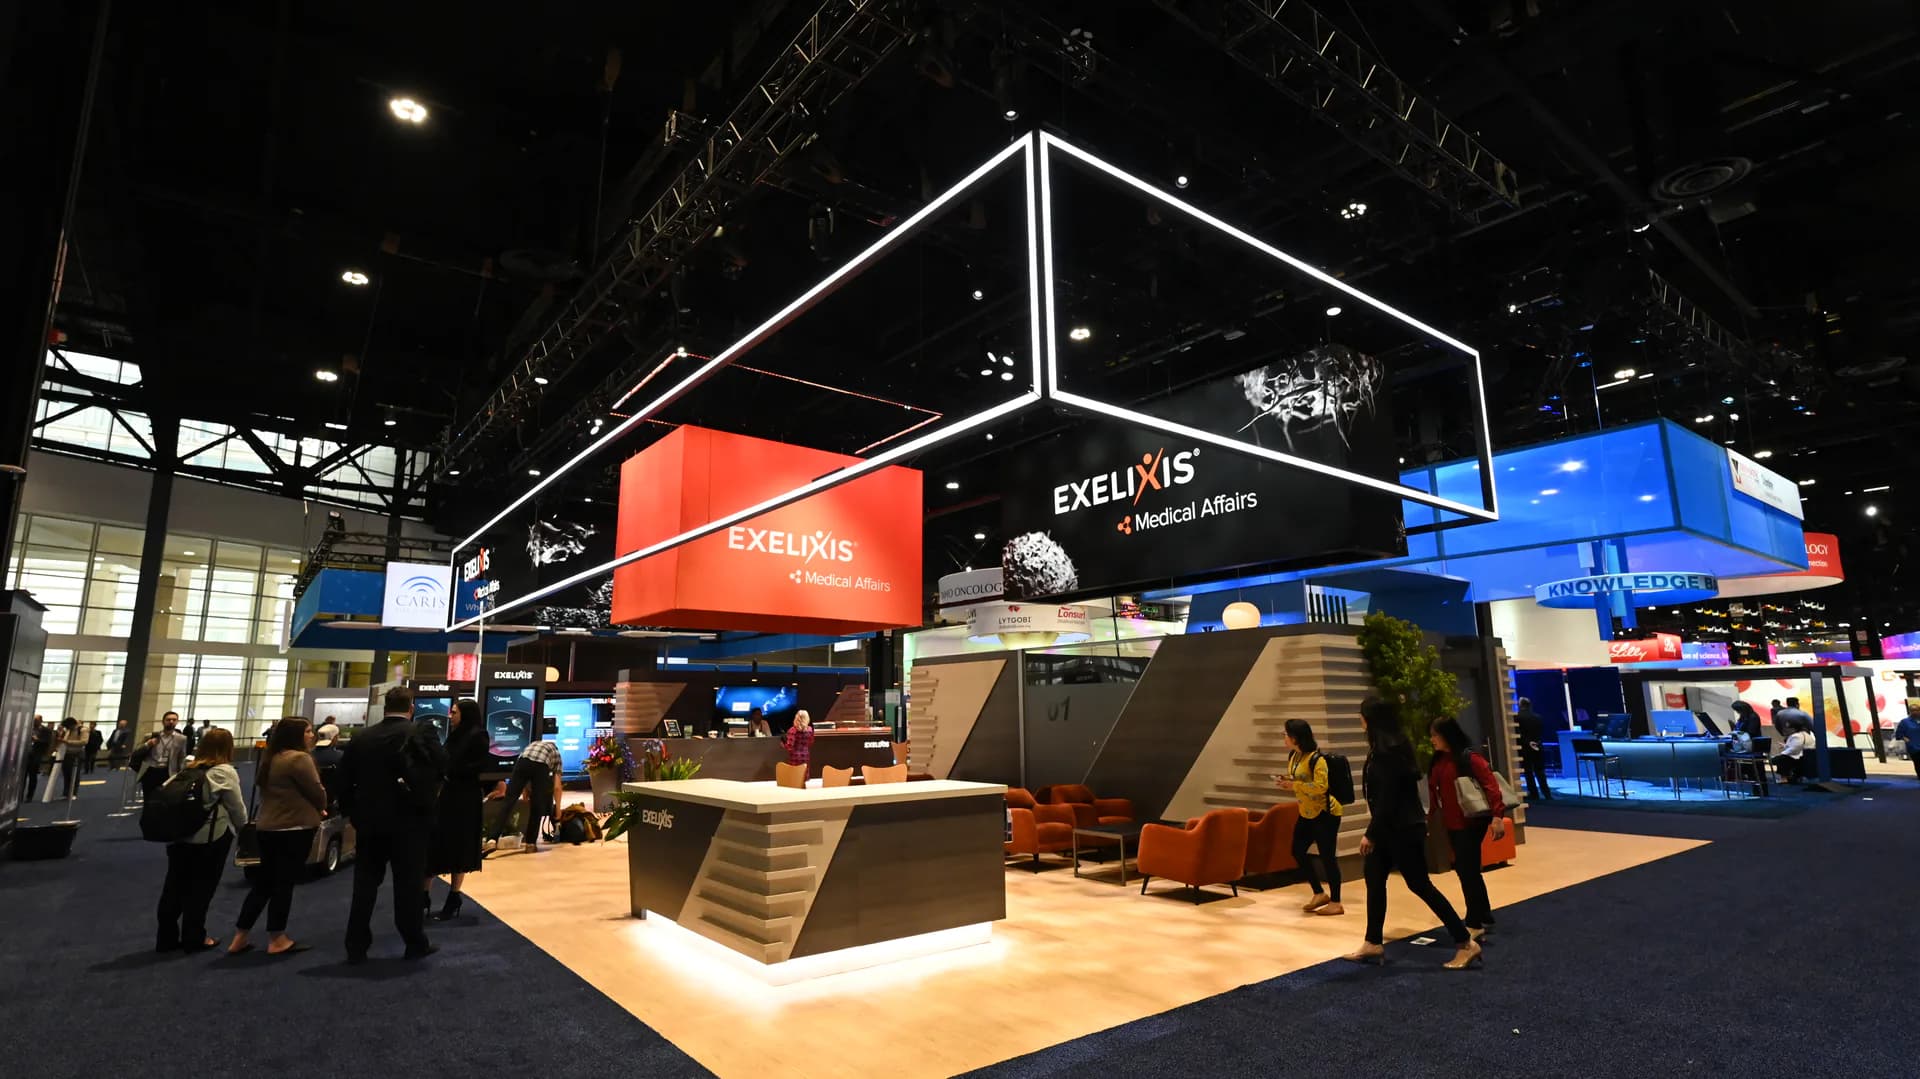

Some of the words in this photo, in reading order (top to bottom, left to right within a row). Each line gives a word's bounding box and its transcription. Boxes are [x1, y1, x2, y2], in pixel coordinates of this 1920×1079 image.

[1135, 501, 1196, 532] Medical
[1201, 491, 1258, 519] Affairs
[1805, 544, 1828, 555] LOGY
[805, 570, 852, 588] Medical
[854, 576, 891, 593] Affairs
[955, 582, 1002, 597] ONCOLOG
[1548, 575, 1699, 598] KNOWLEDGE
[395, 594, 446, 609] CARIS
[998, 616, 1032, 625] LYTGOBI
[1610, 642, 1648, 662] Lilly
[494, 671, 534, 681] EXELIXIS
[642, 808, 674, 830] EXELIXIS
